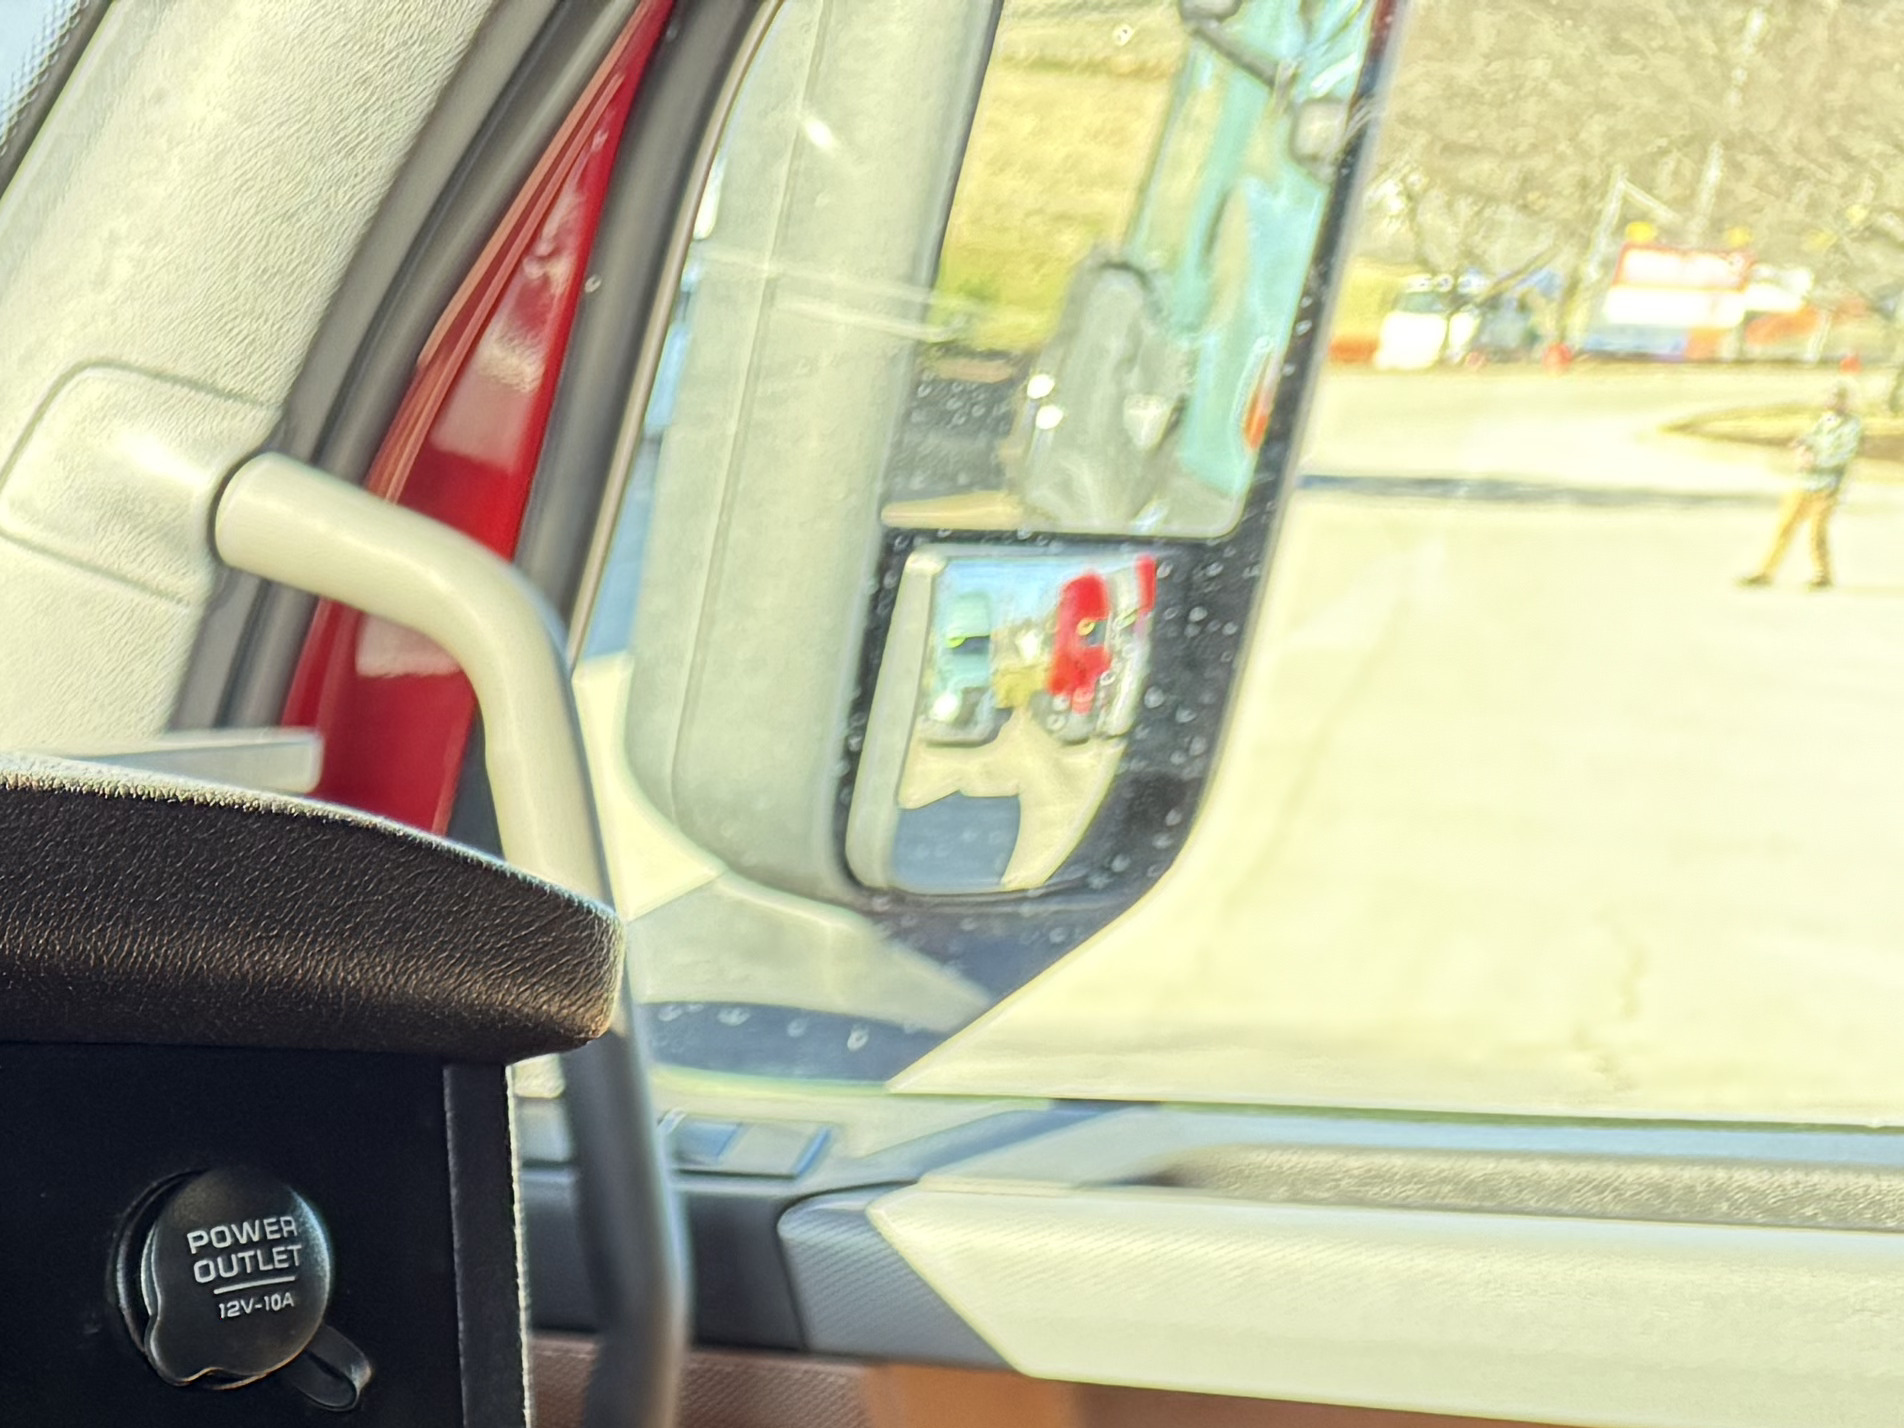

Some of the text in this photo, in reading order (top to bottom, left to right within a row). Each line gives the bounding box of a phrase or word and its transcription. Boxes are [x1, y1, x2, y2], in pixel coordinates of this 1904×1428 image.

[187, 1216, 298, 1254] POWER
[193, 1245, 302, 1284] OUTLET
[218, 1292, 295, 1319] 12V-10A
